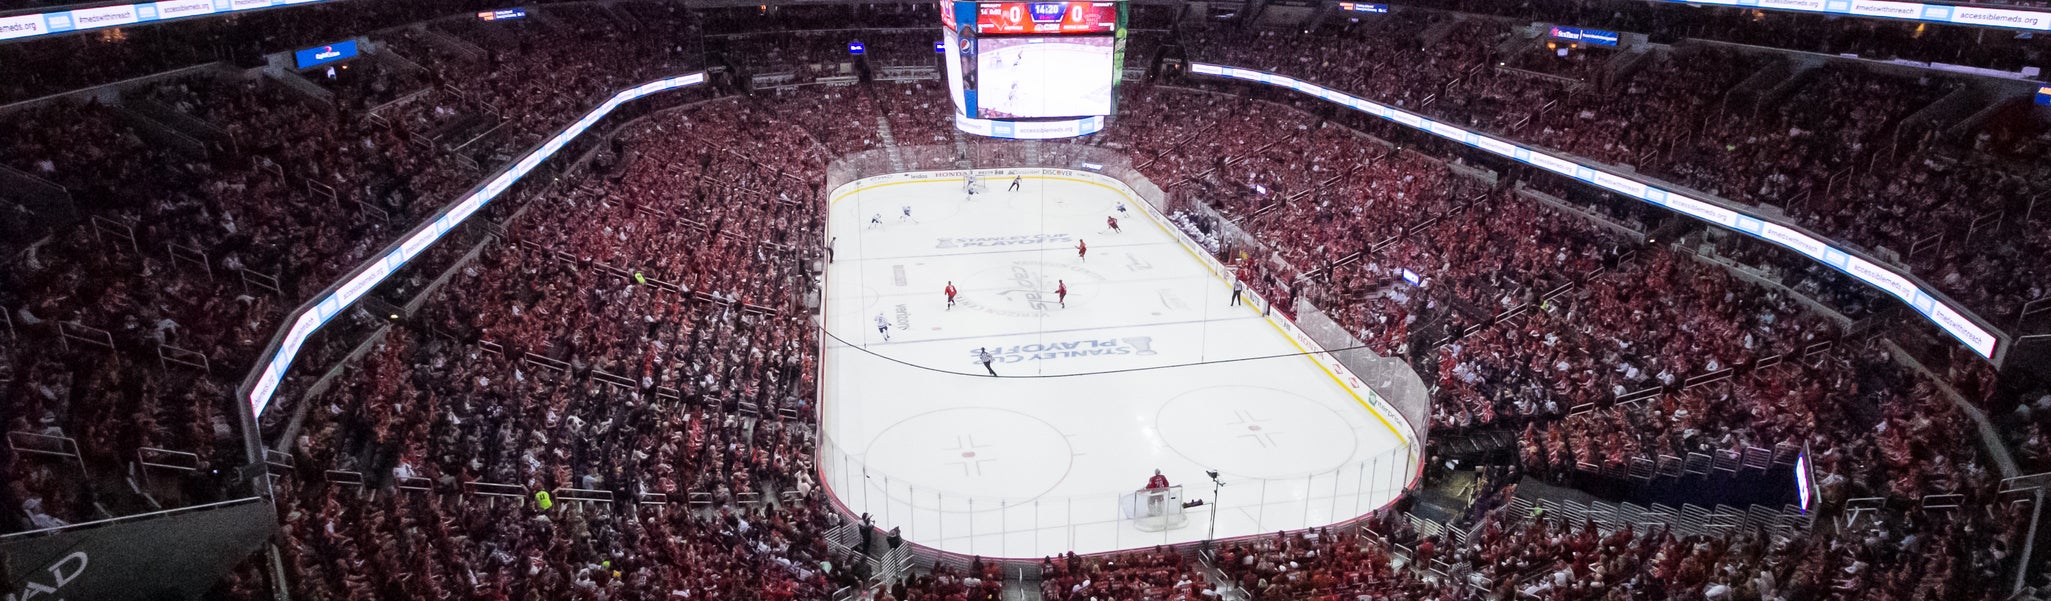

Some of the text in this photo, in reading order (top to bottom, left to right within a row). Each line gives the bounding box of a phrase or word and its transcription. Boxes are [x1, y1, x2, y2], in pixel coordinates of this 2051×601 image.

[1009, 6, 1020, 23] 0
[1035, 4, 1059, 14] 14:20
[1071, 5, 1083, 23] 0
[1855, 4, 1914, 14] #medswithinreach
[1960, 12, 2039, 26] accessiblemeds.org
[1042, 169, 1073, 177] DISCOVER
